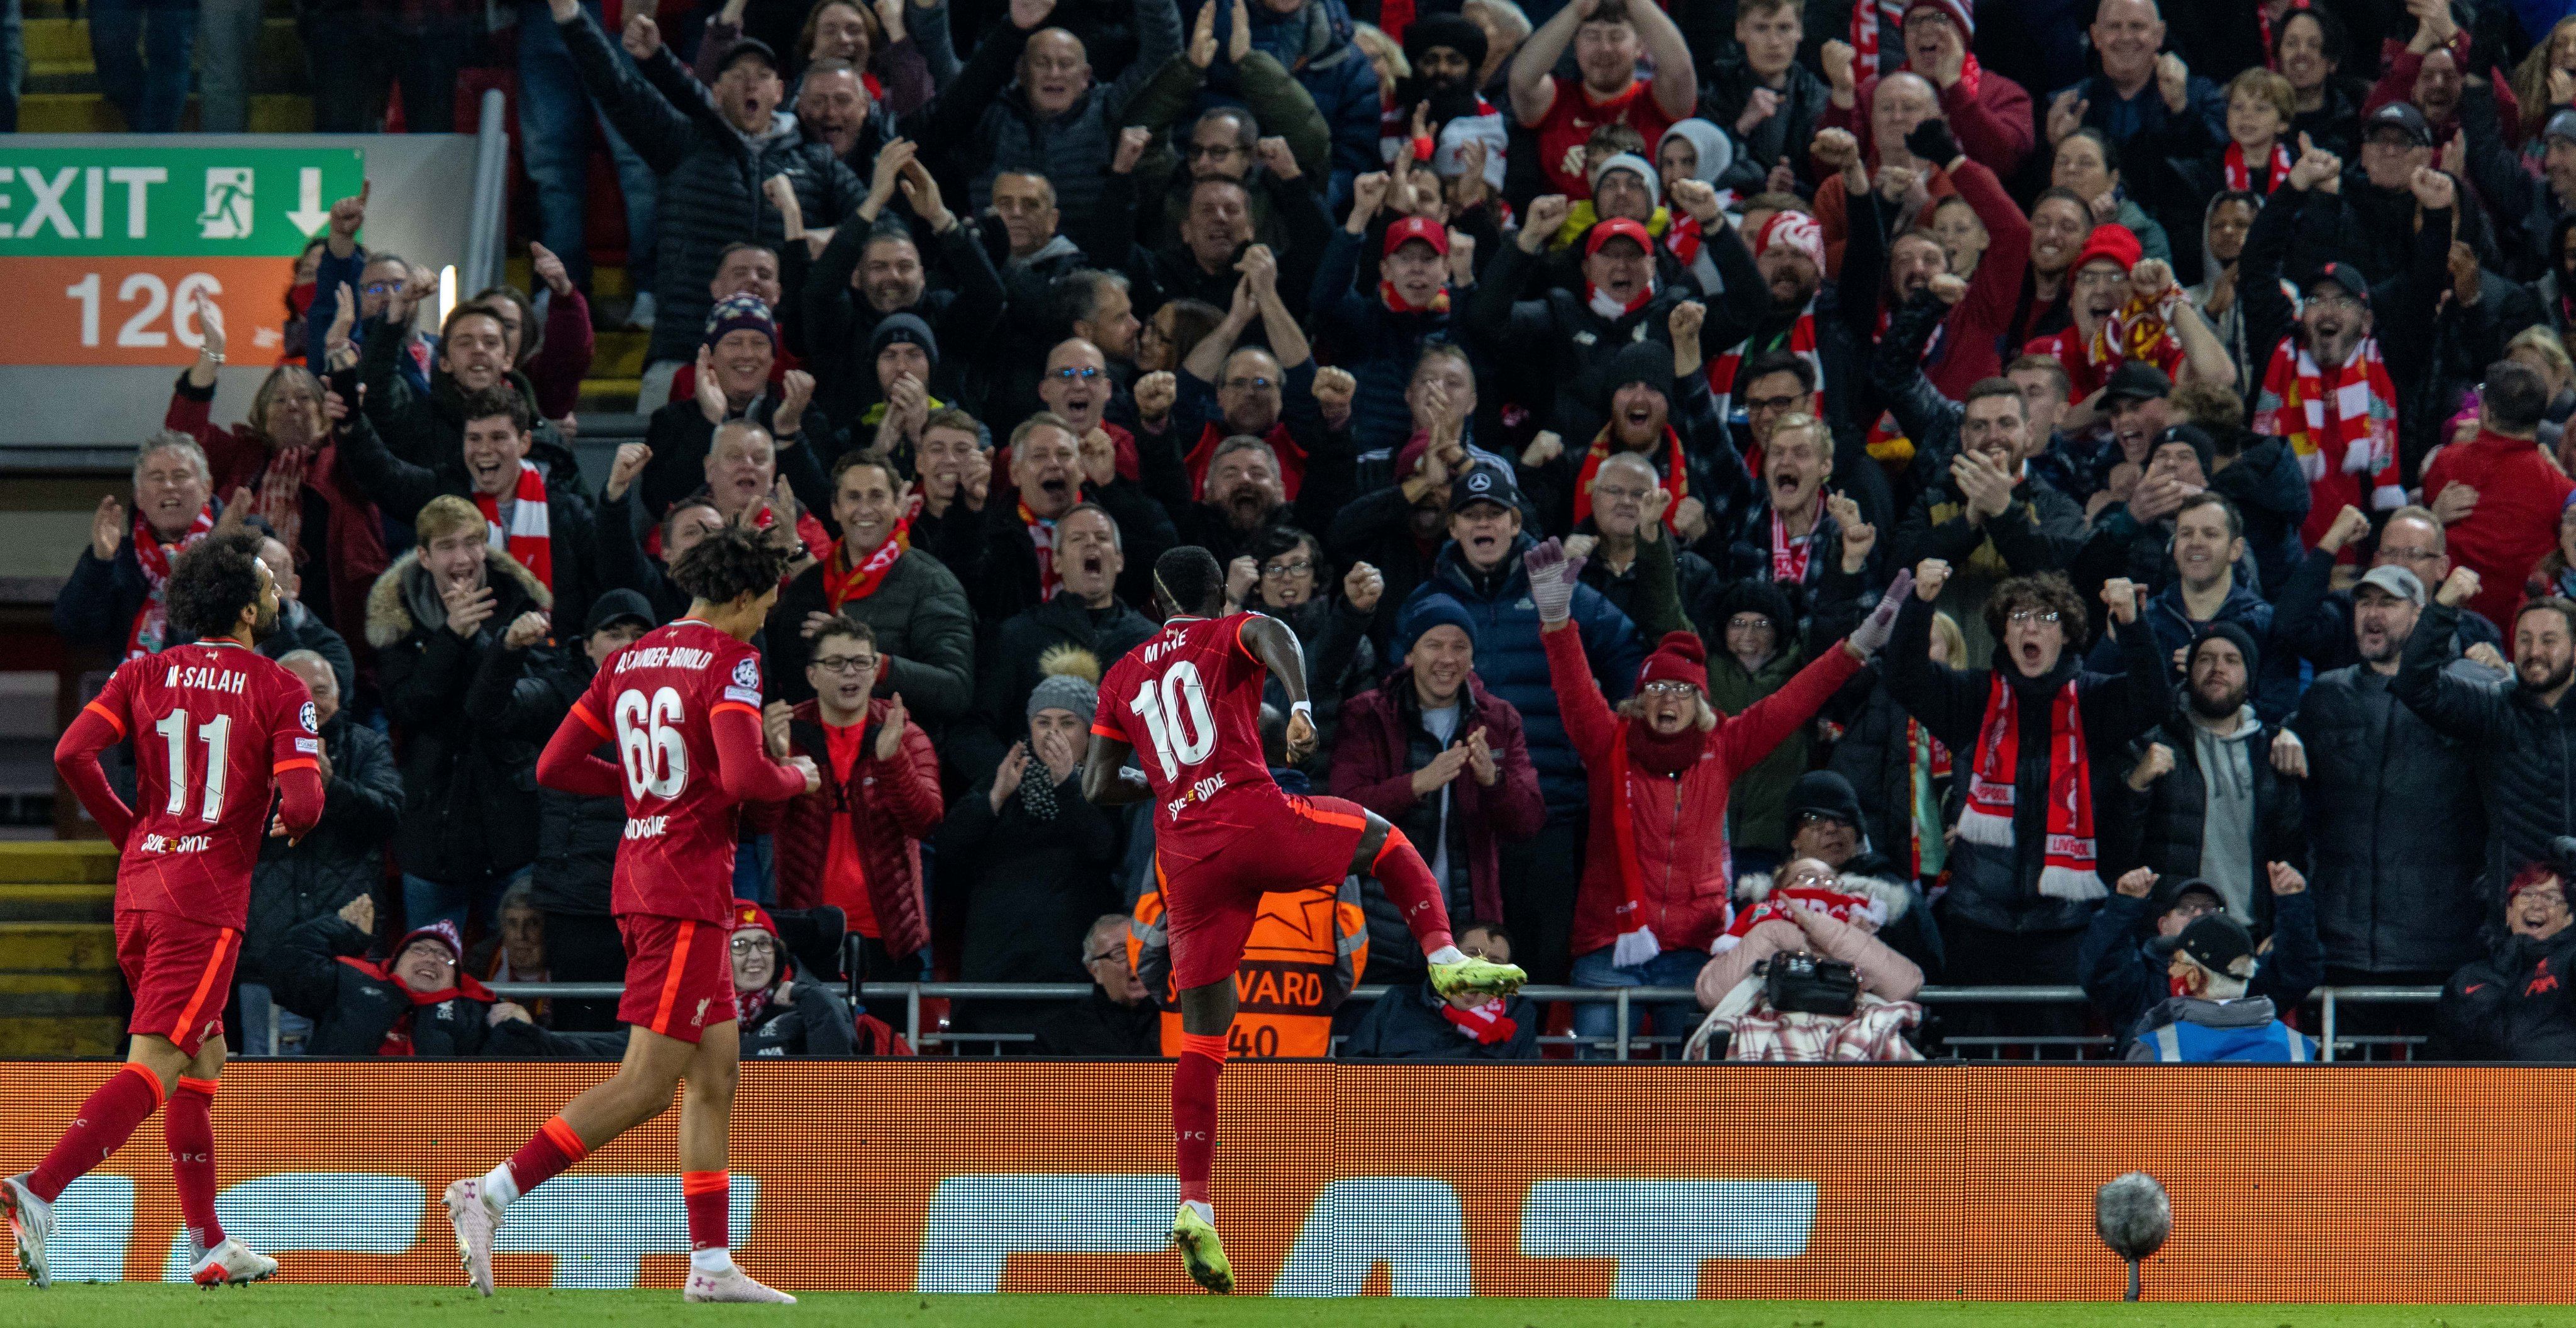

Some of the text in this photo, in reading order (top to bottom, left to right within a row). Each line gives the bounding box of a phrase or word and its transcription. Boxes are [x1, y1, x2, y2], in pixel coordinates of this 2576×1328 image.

[0, 166, 168, 239] XIT
[66, 272, 224, 349] 126
[614, 686, 689, 802] 66
[1130, 660, 1218, 784] 10
[156, 708, 231, 825] 11
[1194, 771, 1227, 802] SIDE
[1167, 968, 1324, 1007] SWARD
